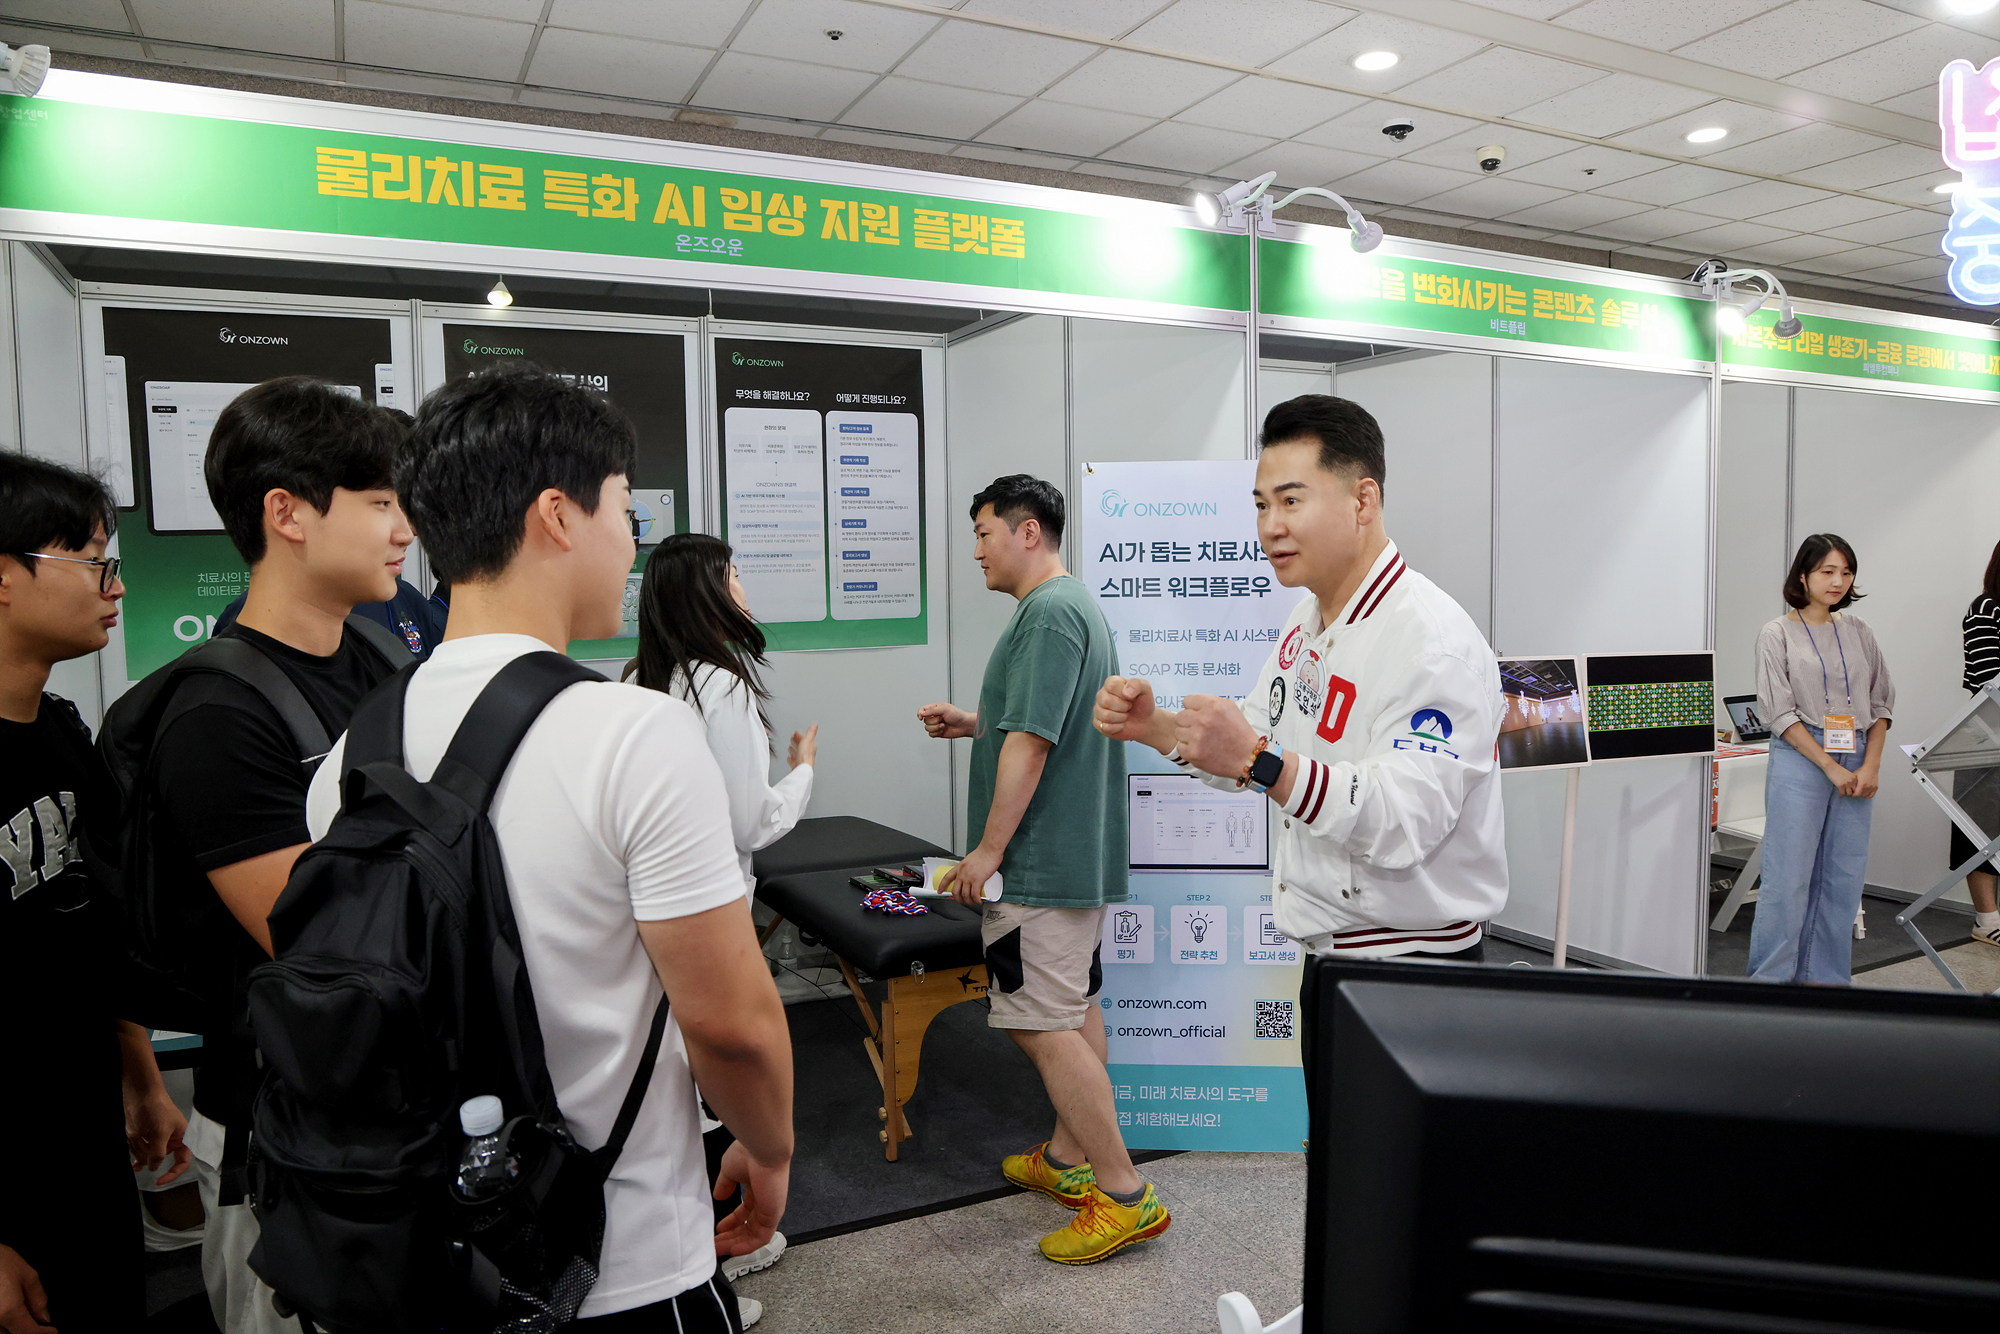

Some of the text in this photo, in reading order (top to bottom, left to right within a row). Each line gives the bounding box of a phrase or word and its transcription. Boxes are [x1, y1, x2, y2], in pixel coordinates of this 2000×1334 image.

[316, 146, 1026, 259] 물리치료 특화 AI 임상 지원 플랫폼
[675, 233, 744, 257] 온즈오운
[1412, 271, 1527, 316] 변화시키는
[1532, 287, 1596, 324] 콘텐츠
[1490, 318, 1526, 336] 비트플립
[239, 335, 288, 346] ONZOWN
[480, 346, 524, 356] ONZOWN
[1795, 331, 1823, 356] 리얼
[1906, 344, 1955, 370] 문맹에서
[746, 358, 784, 368] ONZOWN
[735, 389, 810, 402] 무엇을 해결하나요?
[836, 393, 907, 405] 어떻게 진행되나요?
[1133, 502, 1217, 516] ONZOWN
[1099, 541, 1145, 563] AI가
[1150, 541, 1191, 563] 돕는
[197, 572, 241, 583] 치료사의
[197, 585, 242, 597] 데이터로
[1100, 576, 1271, 598] 스마트 워크플로우
[1128, 629, 1280, 643] 물리치료사 특화 AI 시스템
[1129, 662, 1241, 676] SOAP 자동 문서화
[1316, 674, 1357, 744] D
[1117, 950, 1136, 960] 평가
[1180, 950, 1218, 961] 전략 추천
[1249, 951, 1296, 962] 보고서 생성
[1117, 998, 1207, 1010] onzown.com
[1117, 1025, 1226, 1039] onzown_official
[1139, 1085, 1166, 1101] 미래
[1170, 1086, 1224, 1101] 치료사의
[1227, 1087, 1269, 1102] 도구를
[1135, 1111, 1221, 1128] 체험해보세요!
